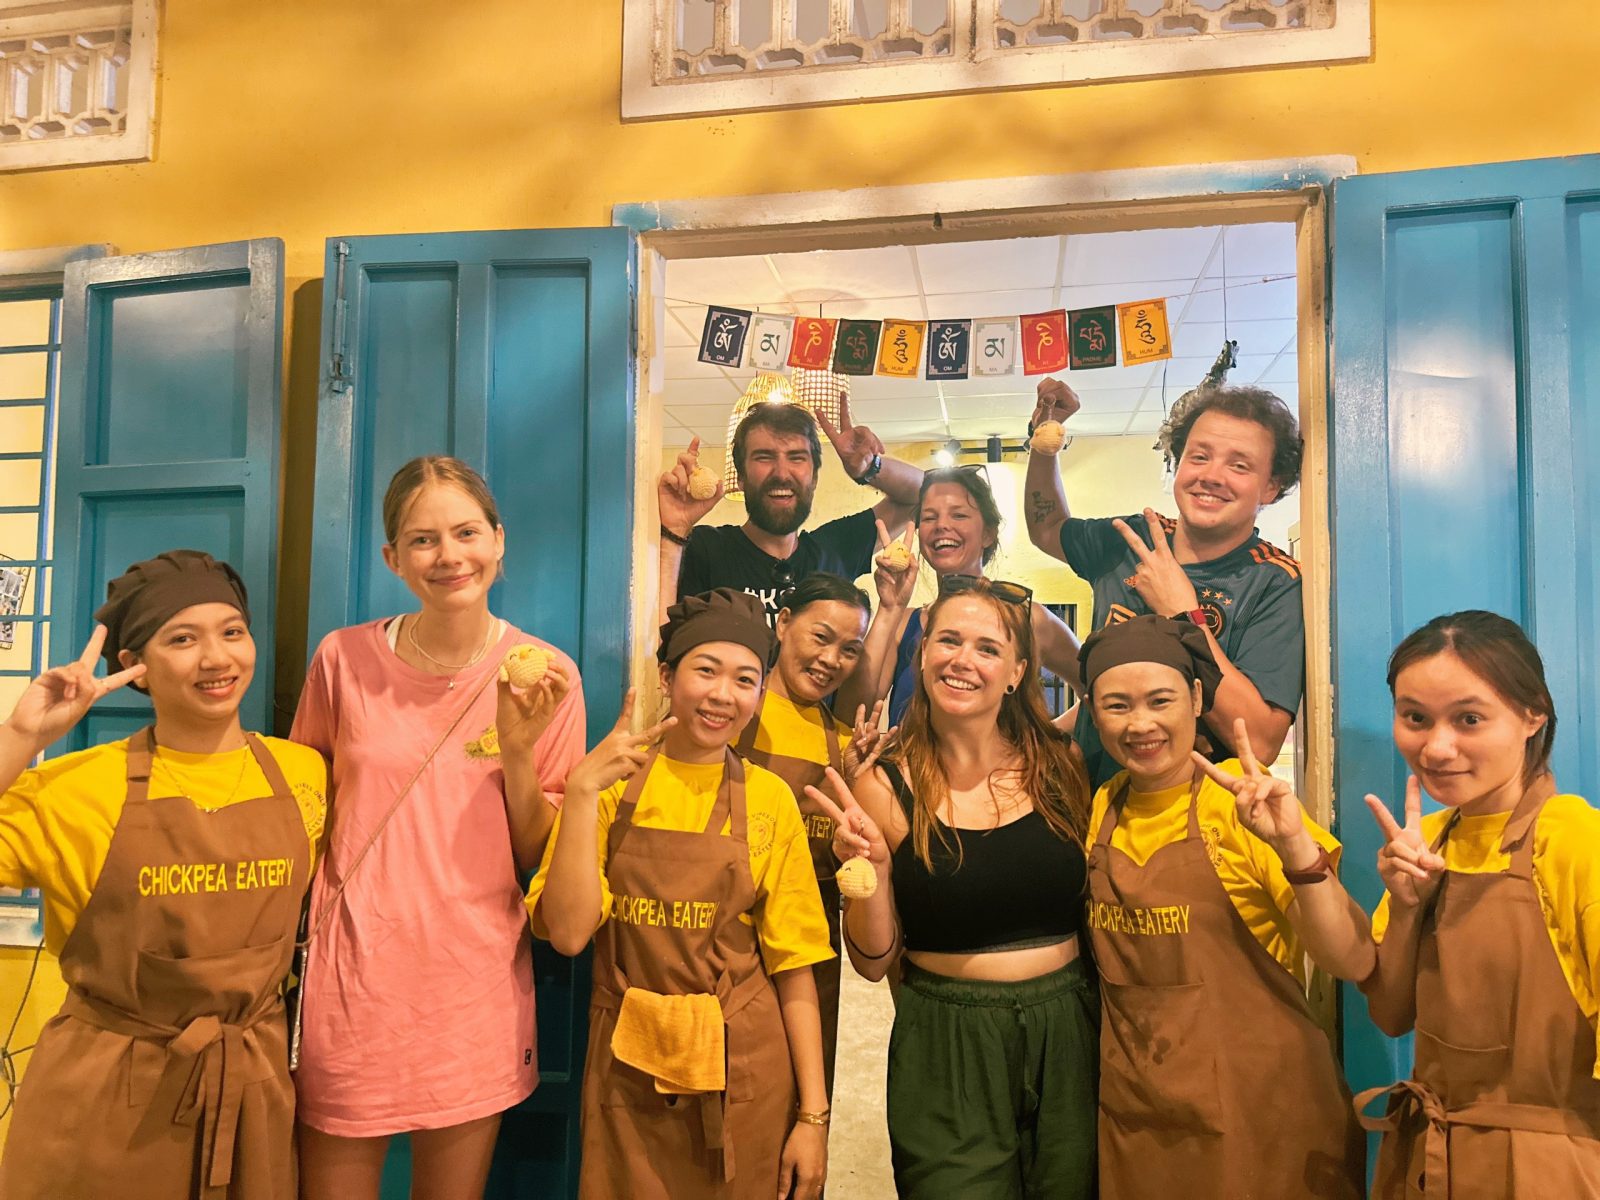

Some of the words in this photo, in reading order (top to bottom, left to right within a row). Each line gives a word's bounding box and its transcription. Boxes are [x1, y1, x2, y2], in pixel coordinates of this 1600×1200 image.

[801, 814, 836, 839] ATERY
[138, 863, 228, 897] CHICKPEA
[235, 858, 294, 891] EATERY
[672, 901, 720, 929] EATERY
[1134, 904, 1190, 935] EATERY
